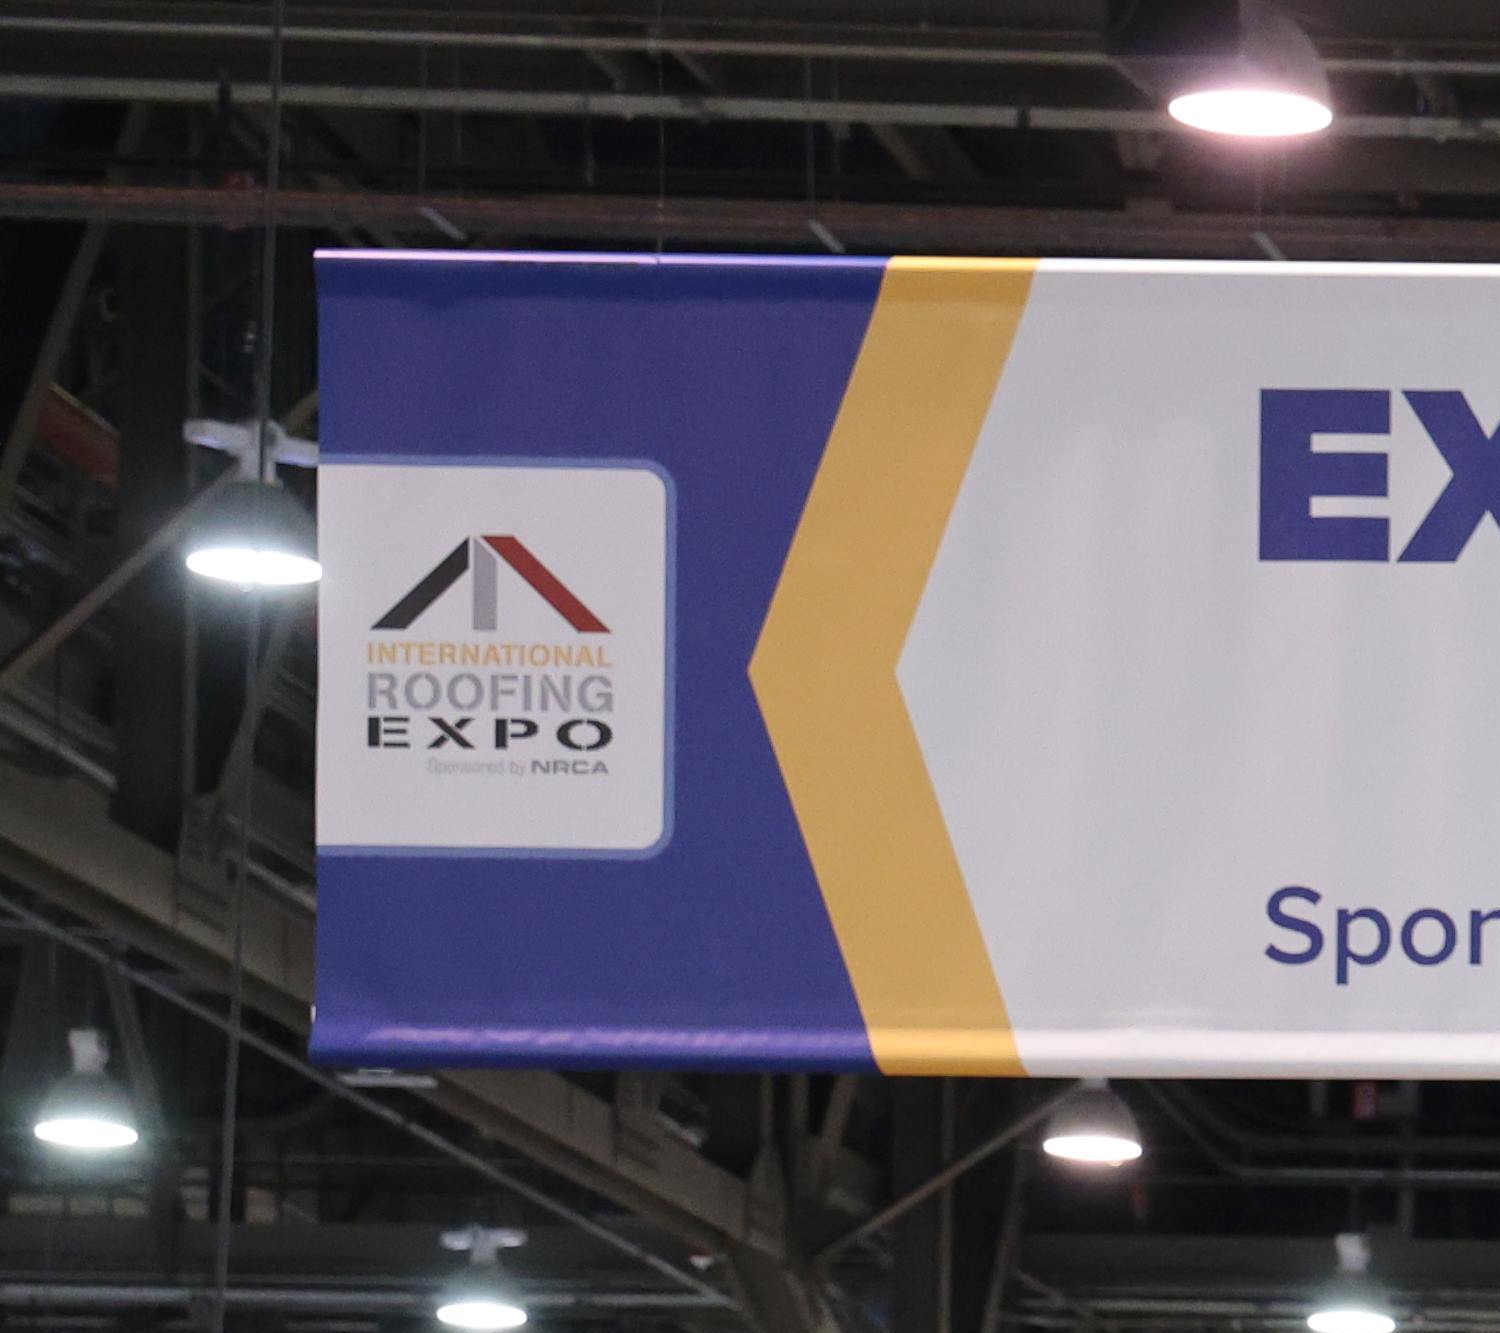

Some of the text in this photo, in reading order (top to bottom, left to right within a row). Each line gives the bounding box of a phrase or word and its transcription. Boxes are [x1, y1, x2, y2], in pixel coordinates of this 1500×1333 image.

[367, 642, 614, 668] INTERNATIONAL
[367, 671, 614, 712] ROOFING
[367, 716, 613, 751] EXPO
[427, 757, 609, 777] Sponsored by NRCA
